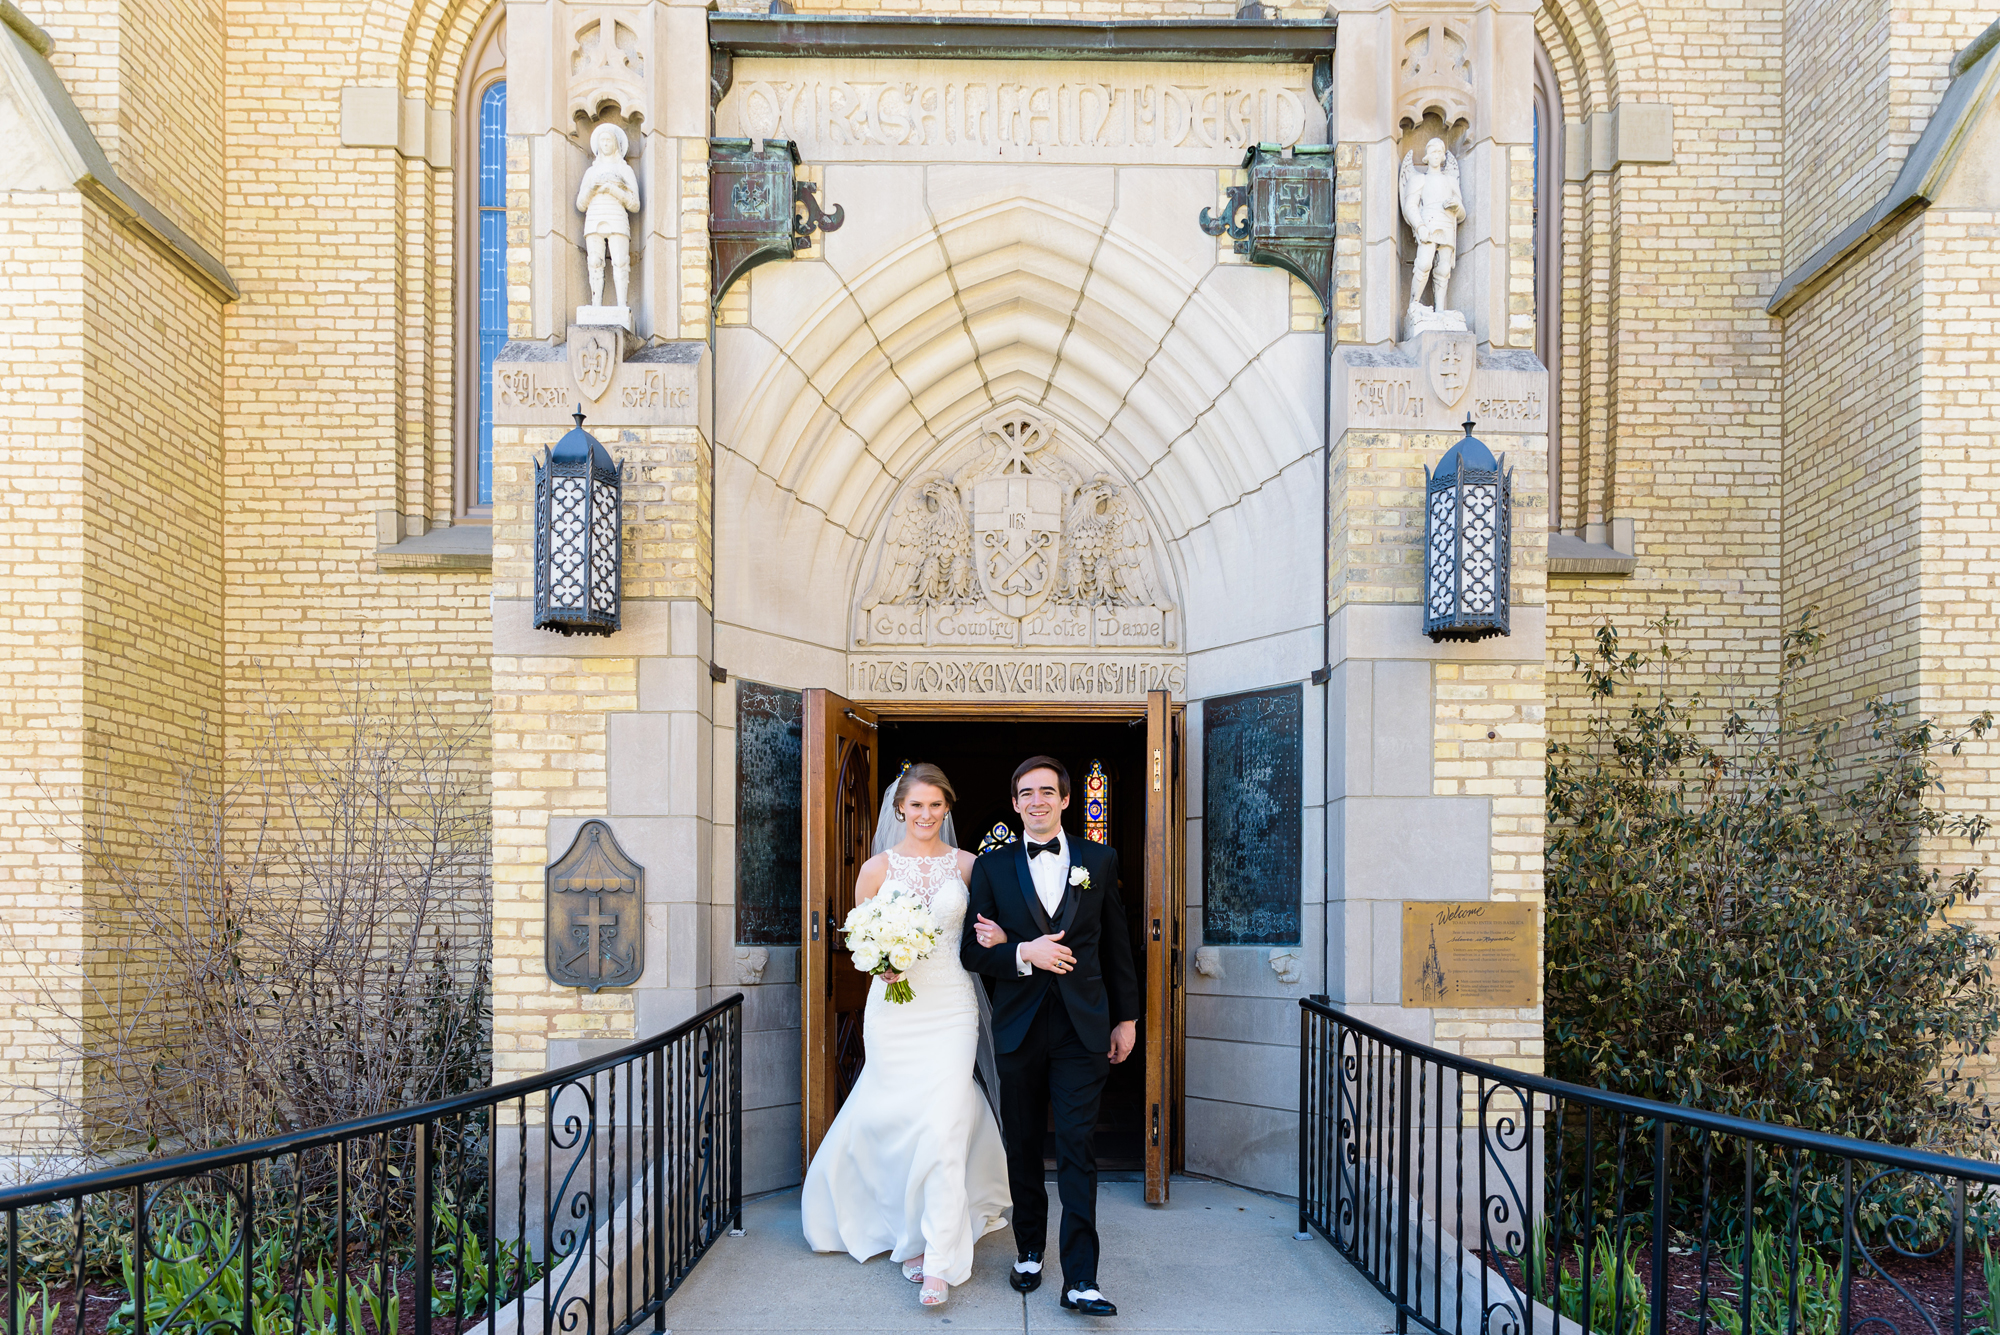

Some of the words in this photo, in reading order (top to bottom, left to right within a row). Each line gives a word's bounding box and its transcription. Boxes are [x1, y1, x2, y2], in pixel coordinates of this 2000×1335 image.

[874, 614, 923, 636] God
[934, 616, 1014, 640] Country
[1027, 616, 1087, 637] Notre
[1098, 617, 1160, 637] Dame
[884, 661, 974, 693] GLORY
[972, 661, 1187, 695] EVERLASTING
[1436, 905, 1485, 925] Welcome
